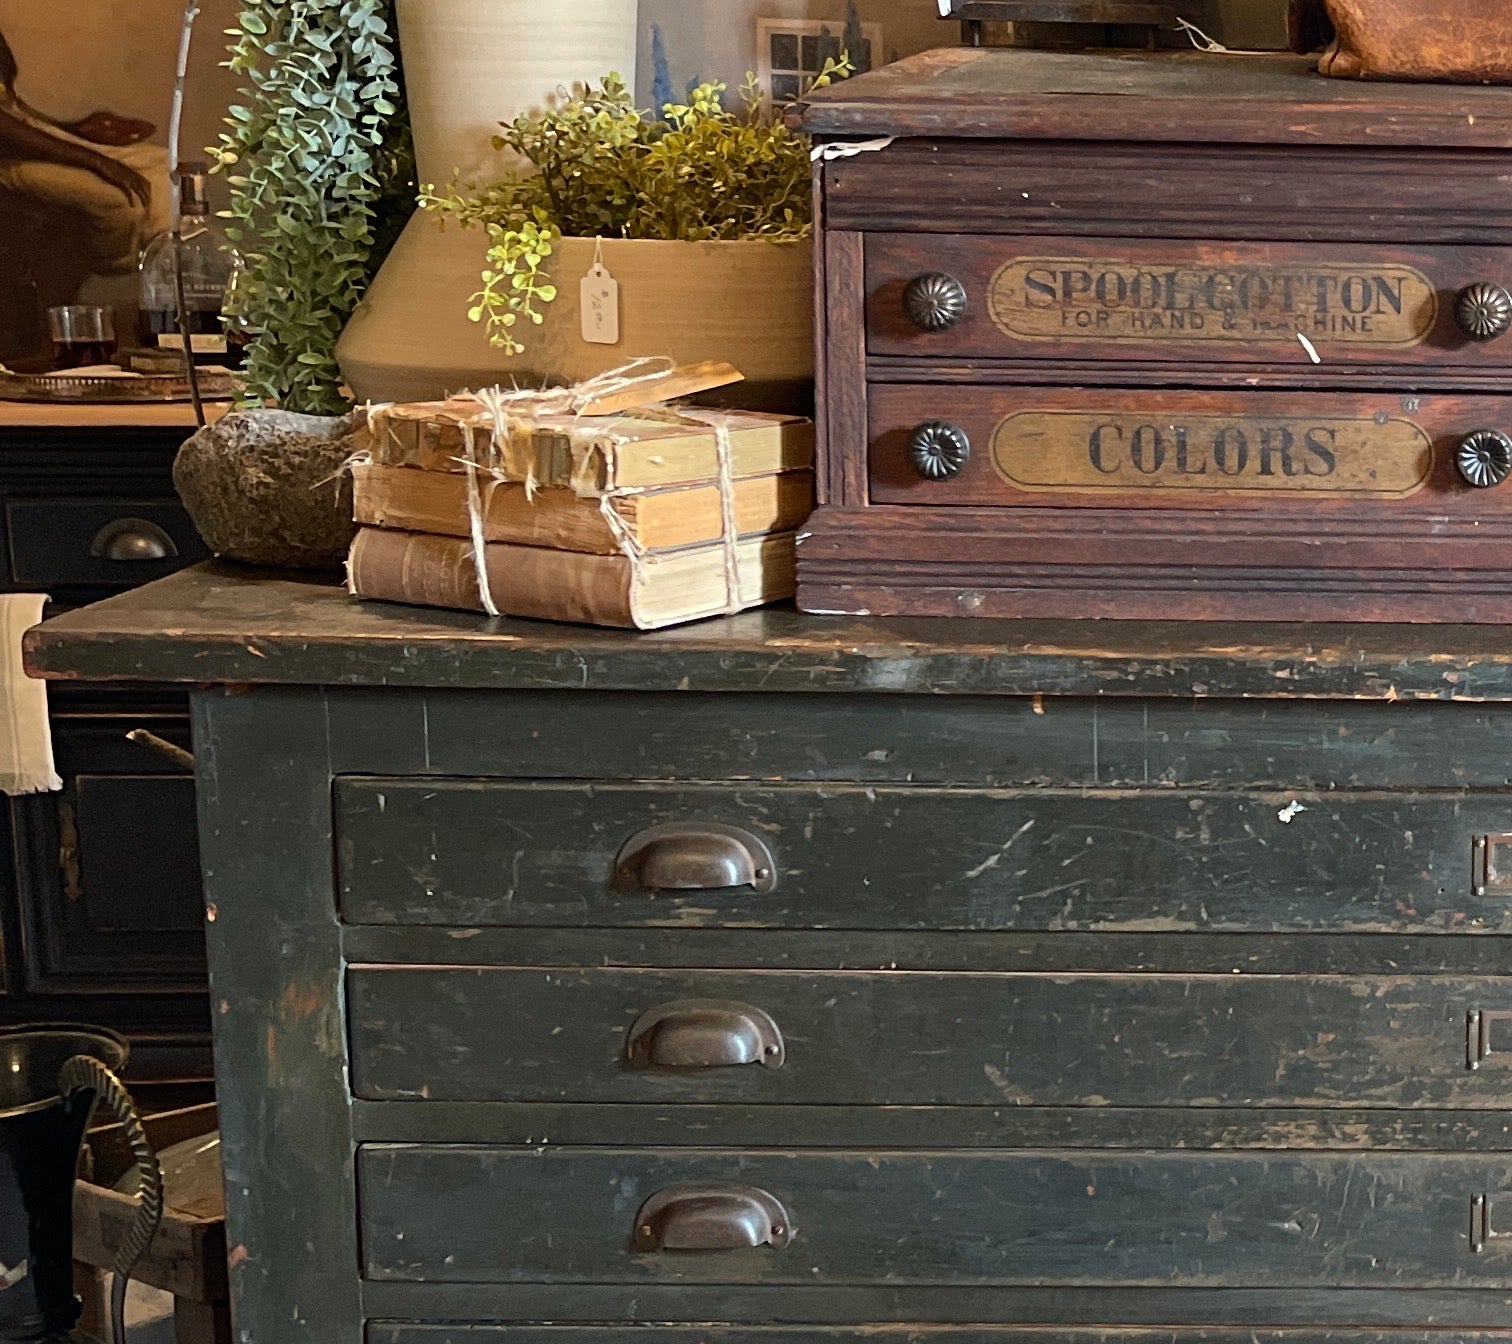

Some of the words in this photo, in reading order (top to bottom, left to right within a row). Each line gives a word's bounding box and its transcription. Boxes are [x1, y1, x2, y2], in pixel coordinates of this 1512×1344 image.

[1061, 310, 1109, 329] FOR
[1131, 311, 1205, 330] HAND
[1222, 306, 1237, 330] &
[1088, 424, 1338, 478] COLORS
